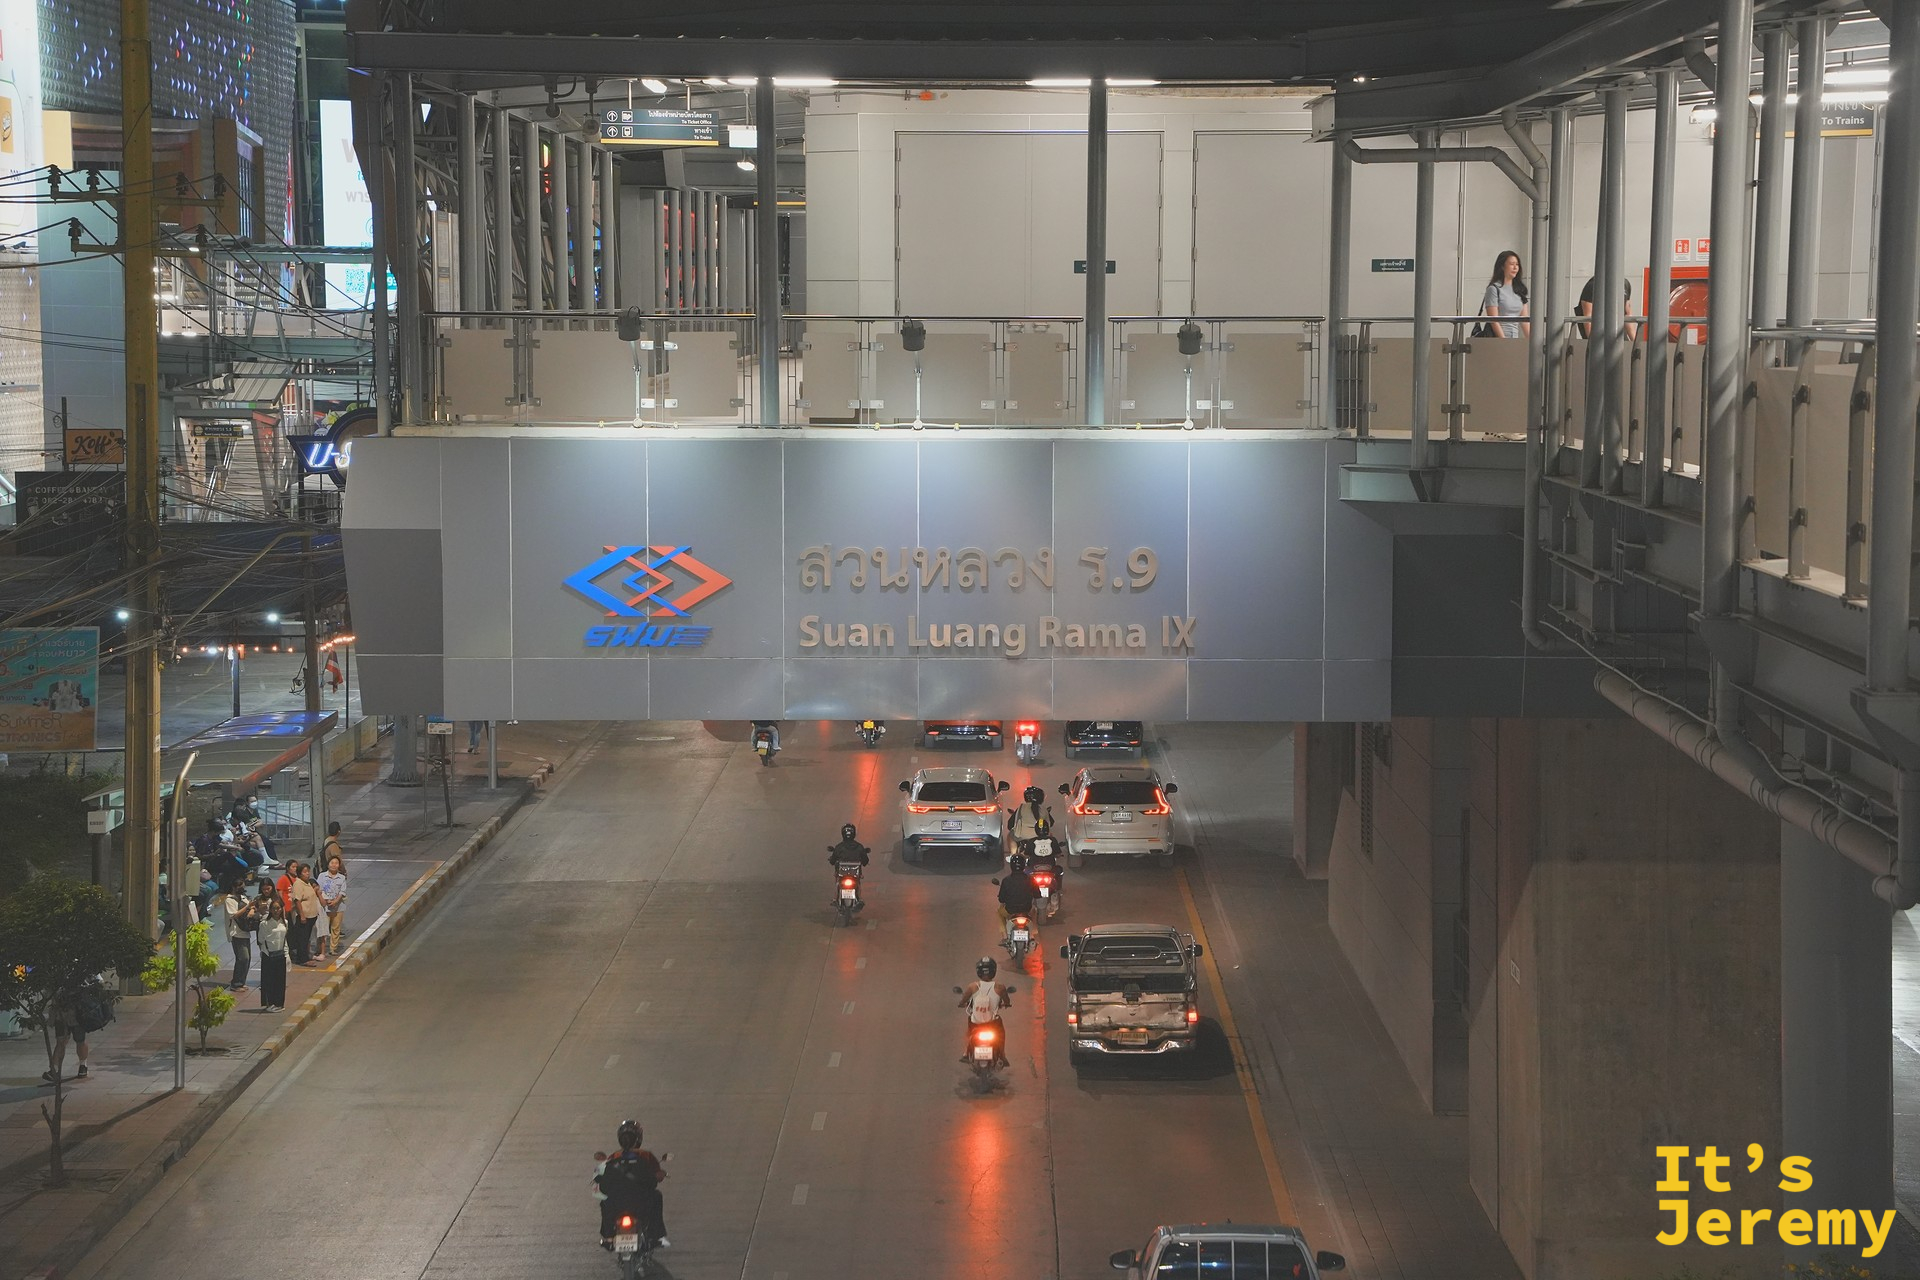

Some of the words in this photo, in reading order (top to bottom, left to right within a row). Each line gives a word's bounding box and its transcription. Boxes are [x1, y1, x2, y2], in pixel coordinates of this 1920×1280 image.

[1821, 117, 1833, 125] To
[1835, 116, 1865, 124] Trains
[799, 543, 1054, 587] สวนหลวง
[1080, 546, 1159, 588] ร.9
[799, 615, 895, 648] Suan
[907, 615, 1026, 656] Luang
[1039, 615, 1146, 648] Rama
[1162, 615, 1197, 648] IX
